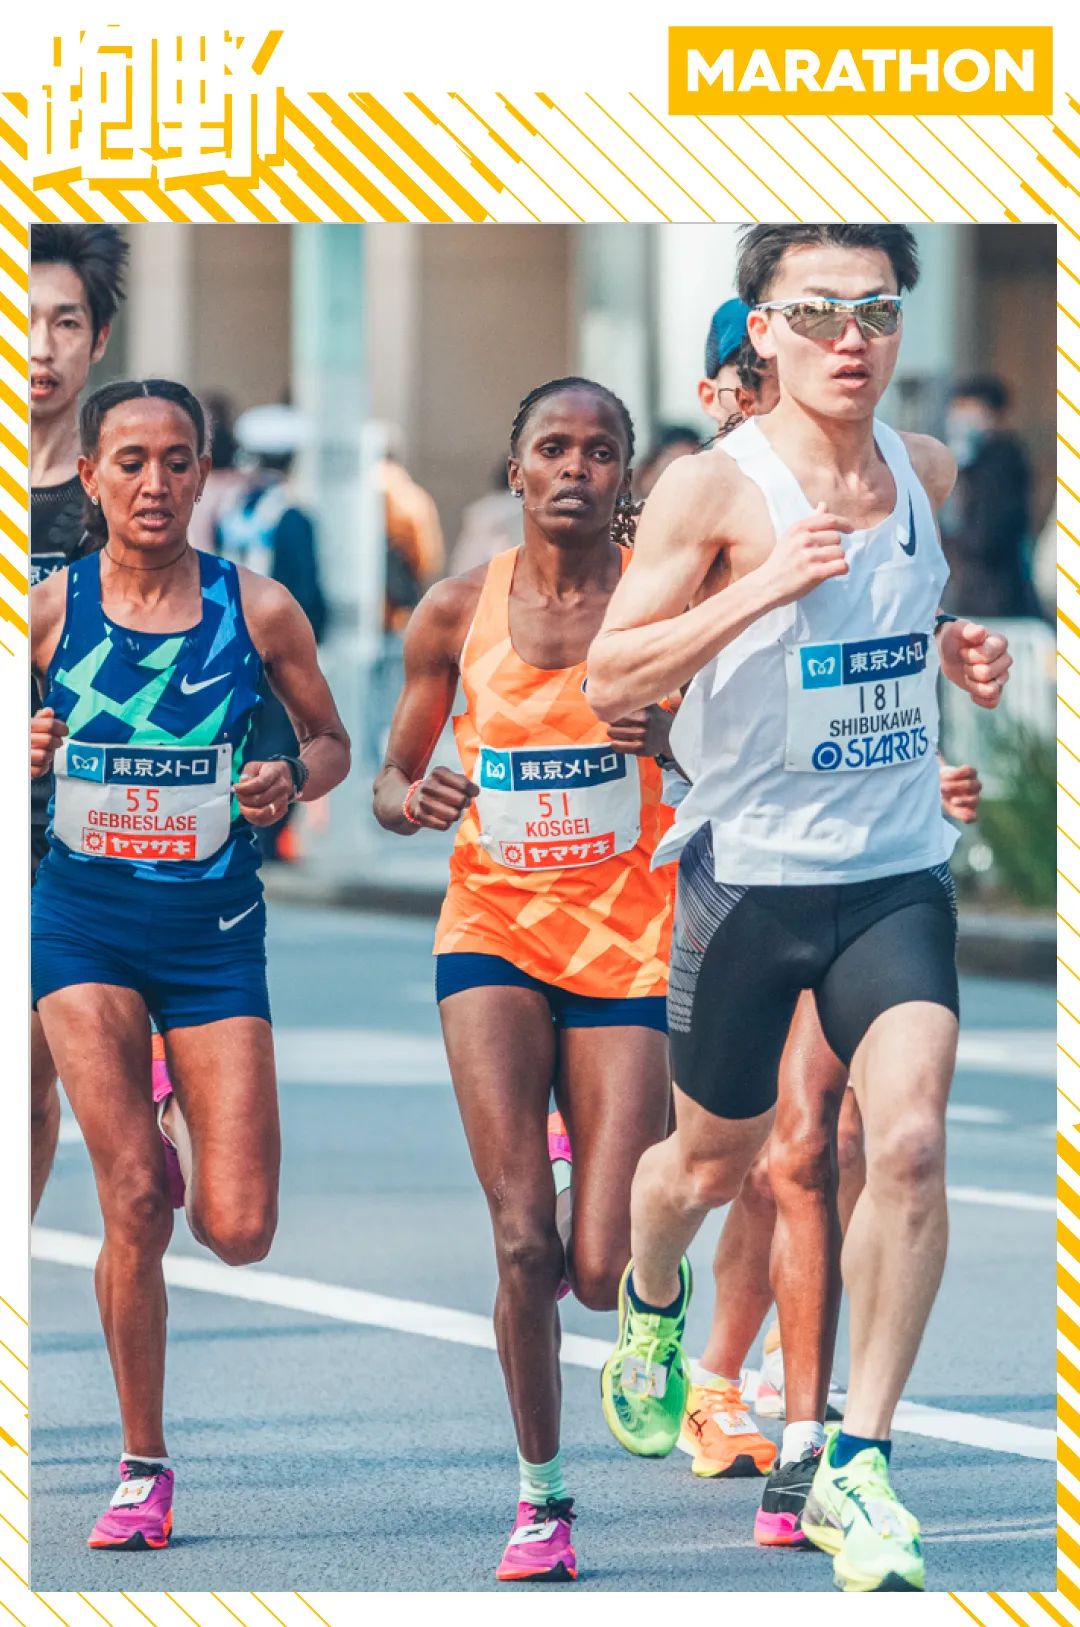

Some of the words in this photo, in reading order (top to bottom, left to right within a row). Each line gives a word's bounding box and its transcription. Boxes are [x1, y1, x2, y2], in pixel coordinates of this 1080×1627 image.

[849, 642, 925, 674] 東京メトロ
[859, 681, 900, 713] 181
[829, 707, 922, 737] SHIBUKAWA
[112, 757, 209, 777] 東京メトロ
[520, 753, 618, 780] 東京メトロ
[126, 788, 160, 813] 55
[538, 792, 569, 818] 51
[88, 810, 197, 831] GEBRESLASE
[525, 818, 590, 837] KOSGEI
[111, 837, 191, 855] ヤマザキ
[528, 839, 610, 863] ヤマザキ
